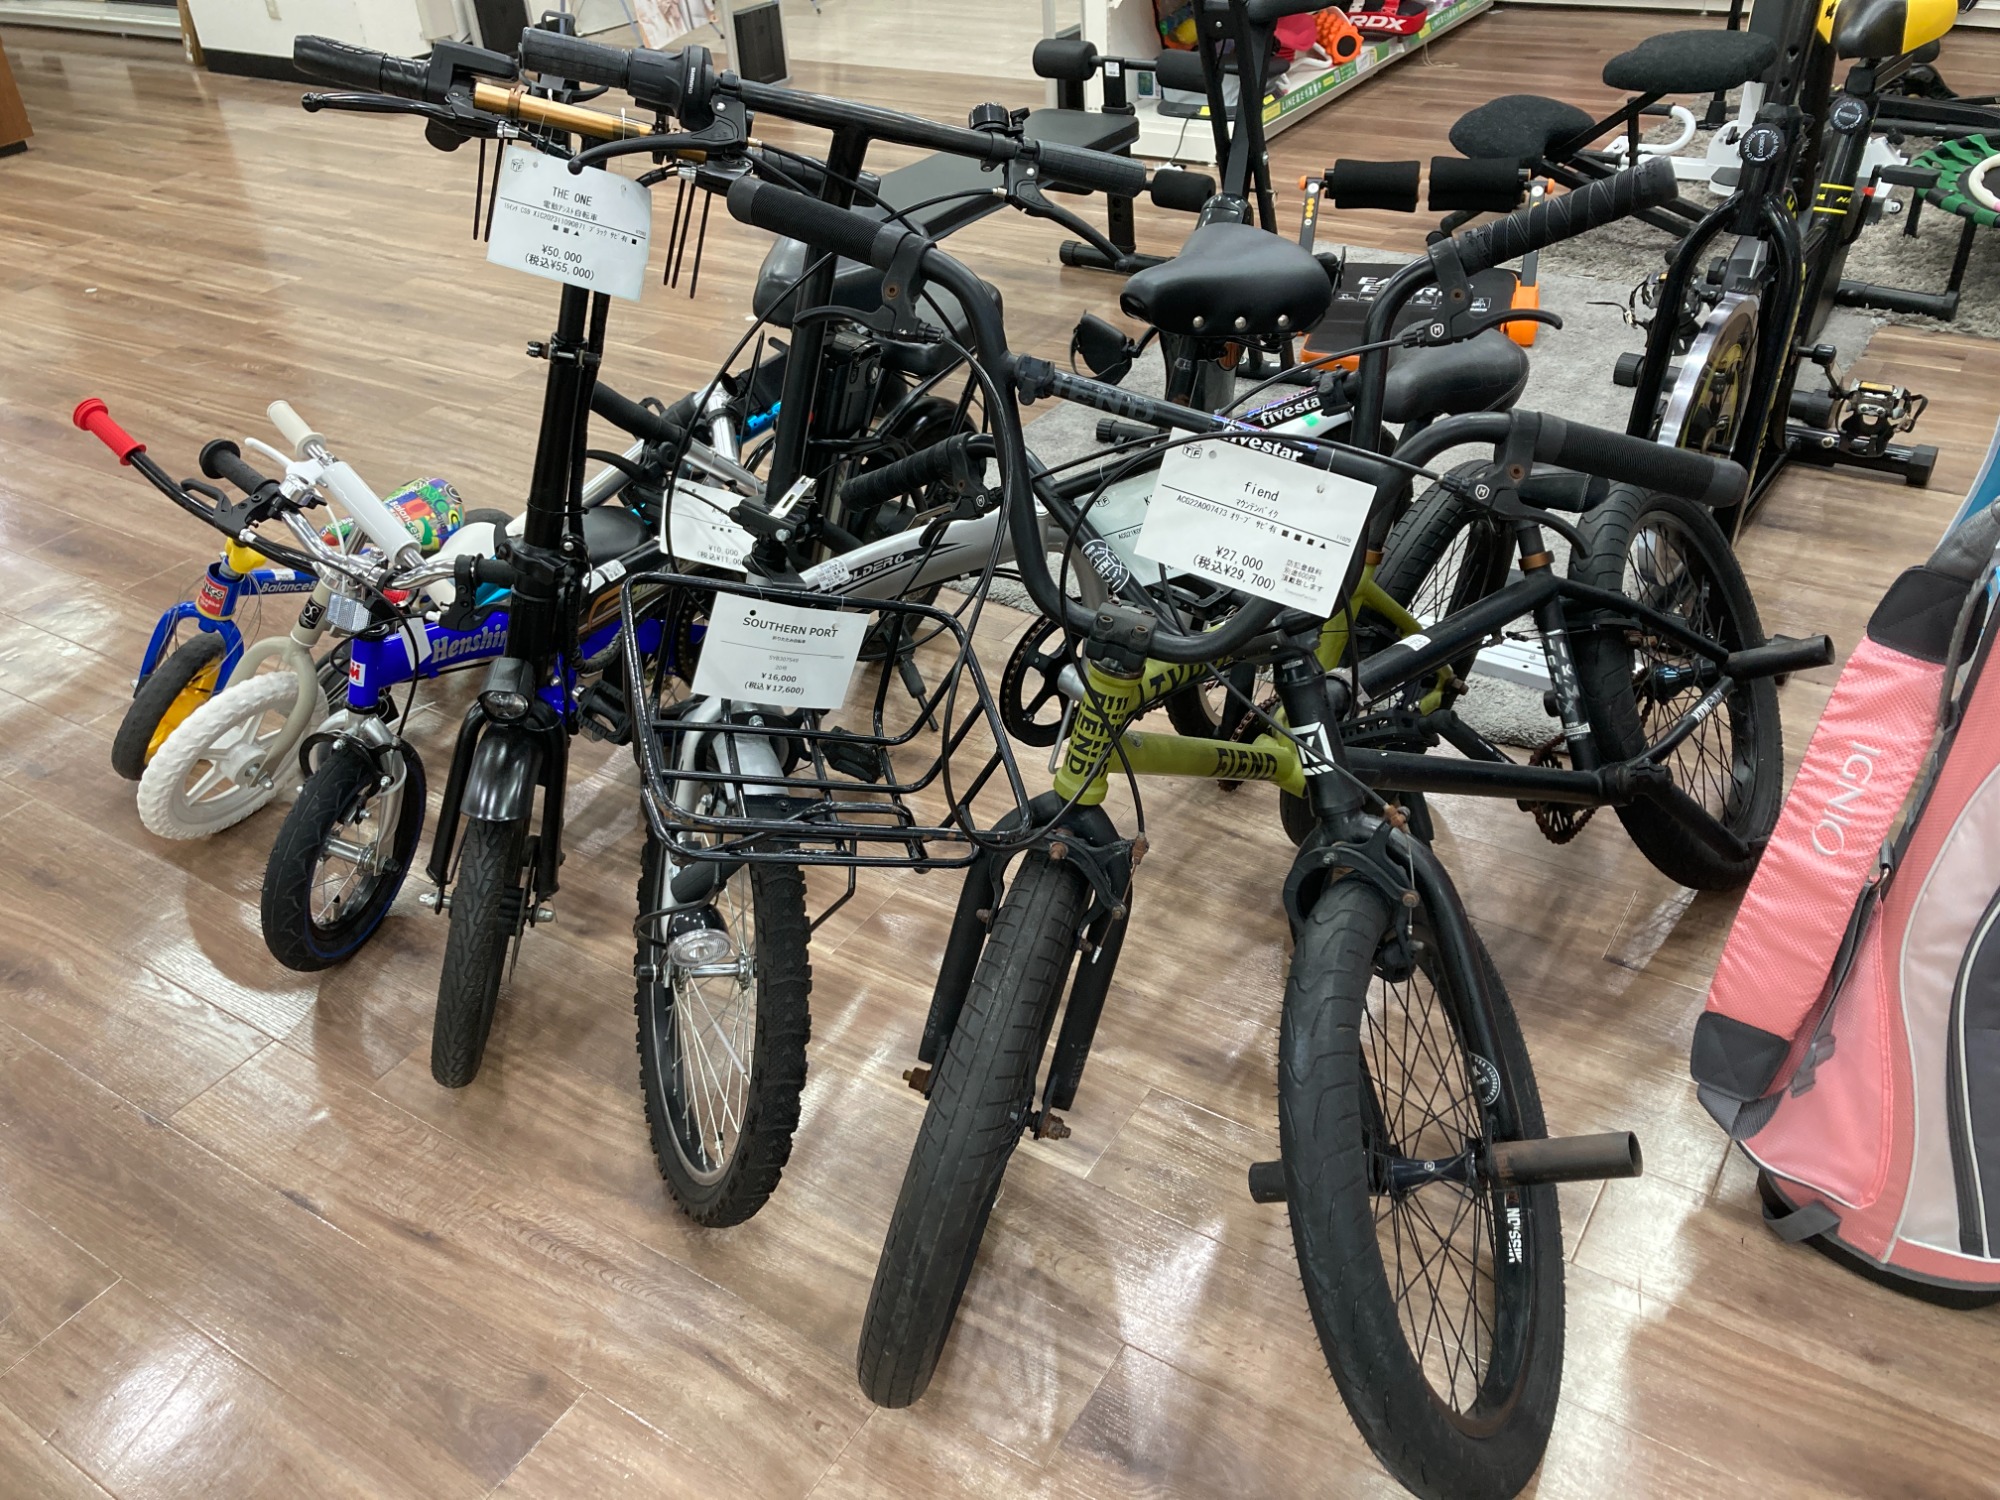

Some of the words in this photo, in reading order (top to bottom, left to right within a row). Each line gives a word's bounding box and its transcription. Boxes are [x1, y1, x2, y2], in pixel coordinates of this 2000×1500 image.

[1350, 15, 1407, 31] RDX
[552, 186, 570, 200] THE
[574, 193, 593, 207] ONE
[542, 244, 582, 264] ¥50,000
[1260, 397, 1321, 426] fivesta
[1244, 482, 1280, 502] fiend
[1215, 545, 1263, 571] ¥27,000
[1193, 554, 1276, 592] (税込¥29,700)
[743, 617, 807, 636] SOUTHERN
[809, 627, 838, 638] PORT
[761, 672, 797, 683] ¥16,000
[1213, 747, 1278, 780] FIEND
[1811, 740, 1882, 855] IGNIO
